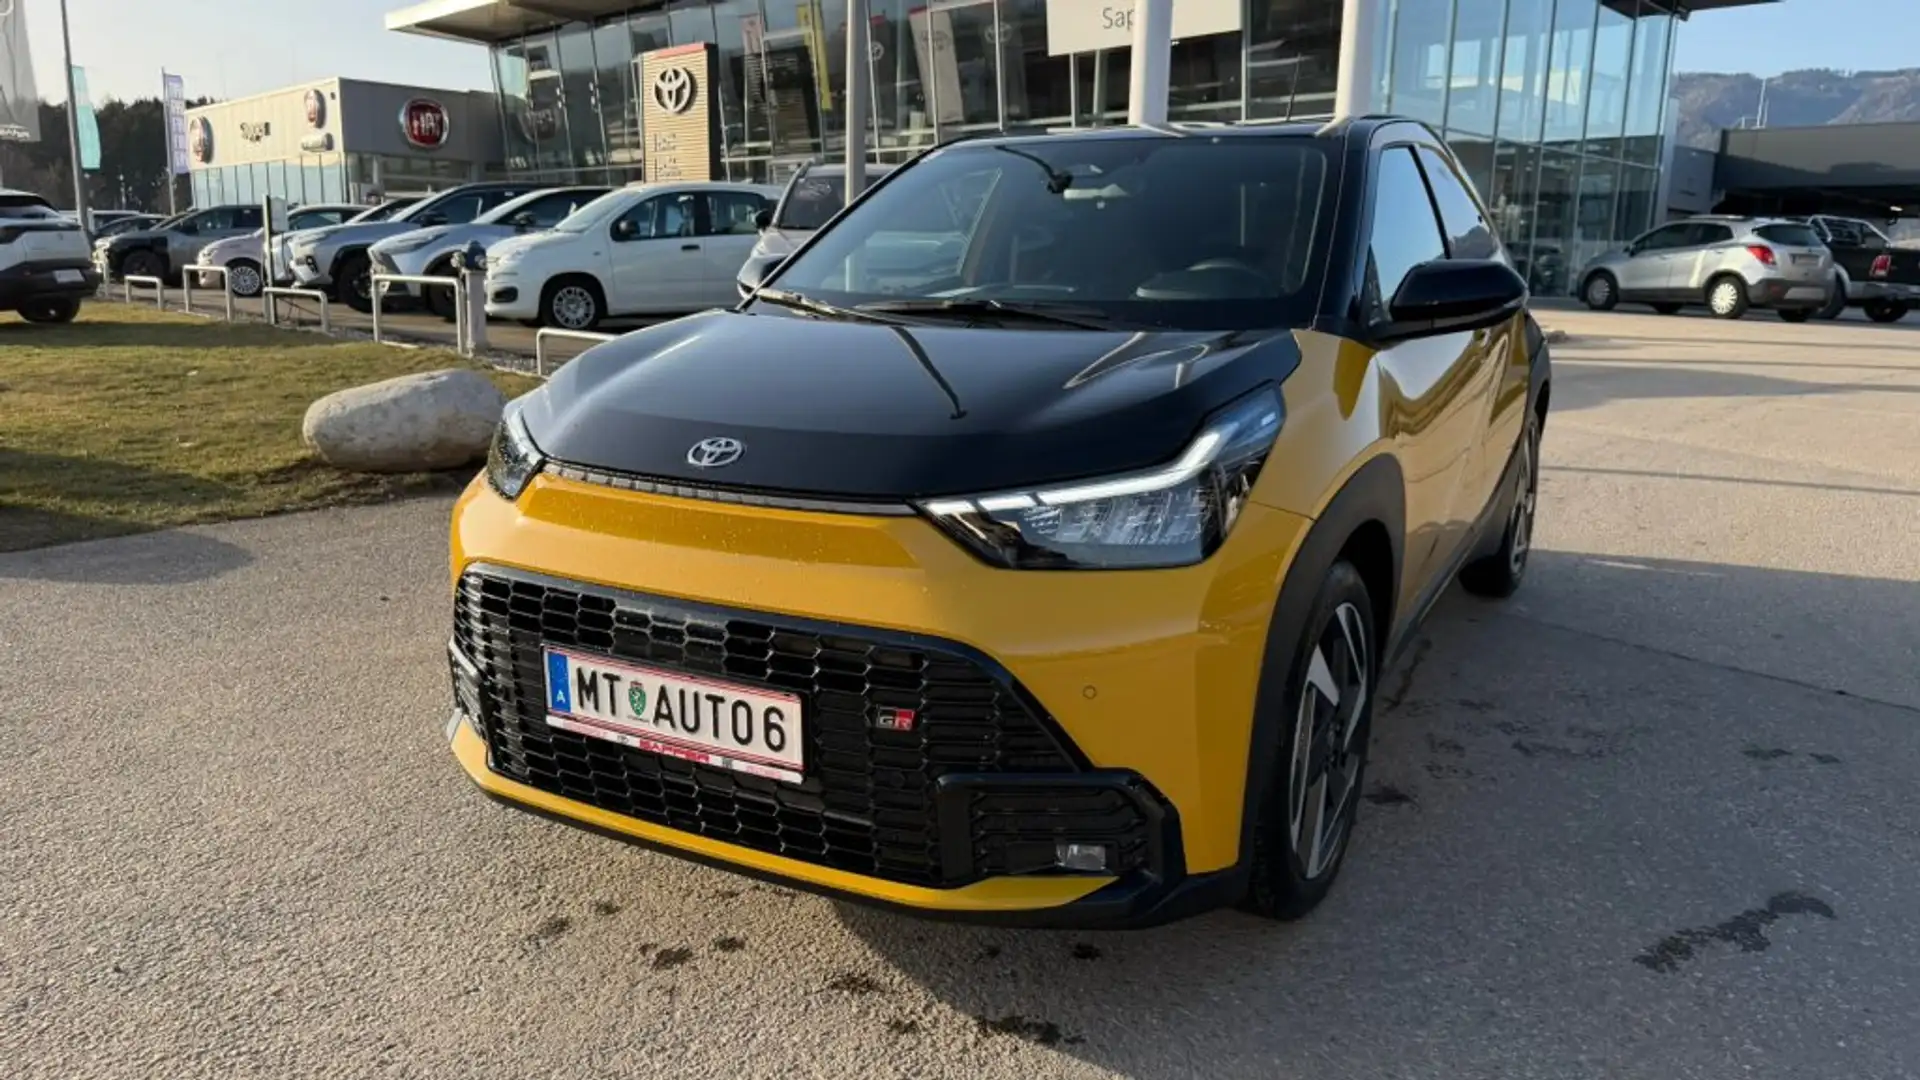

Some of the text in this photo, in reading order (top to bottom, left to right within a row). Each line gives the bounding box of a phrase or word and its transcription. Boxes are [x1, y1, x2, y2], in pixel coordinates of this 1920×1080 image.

[556, 690, 566, 704] A
[576, 666, 621, 717] MT
[879, 716, 912, 731] GR
